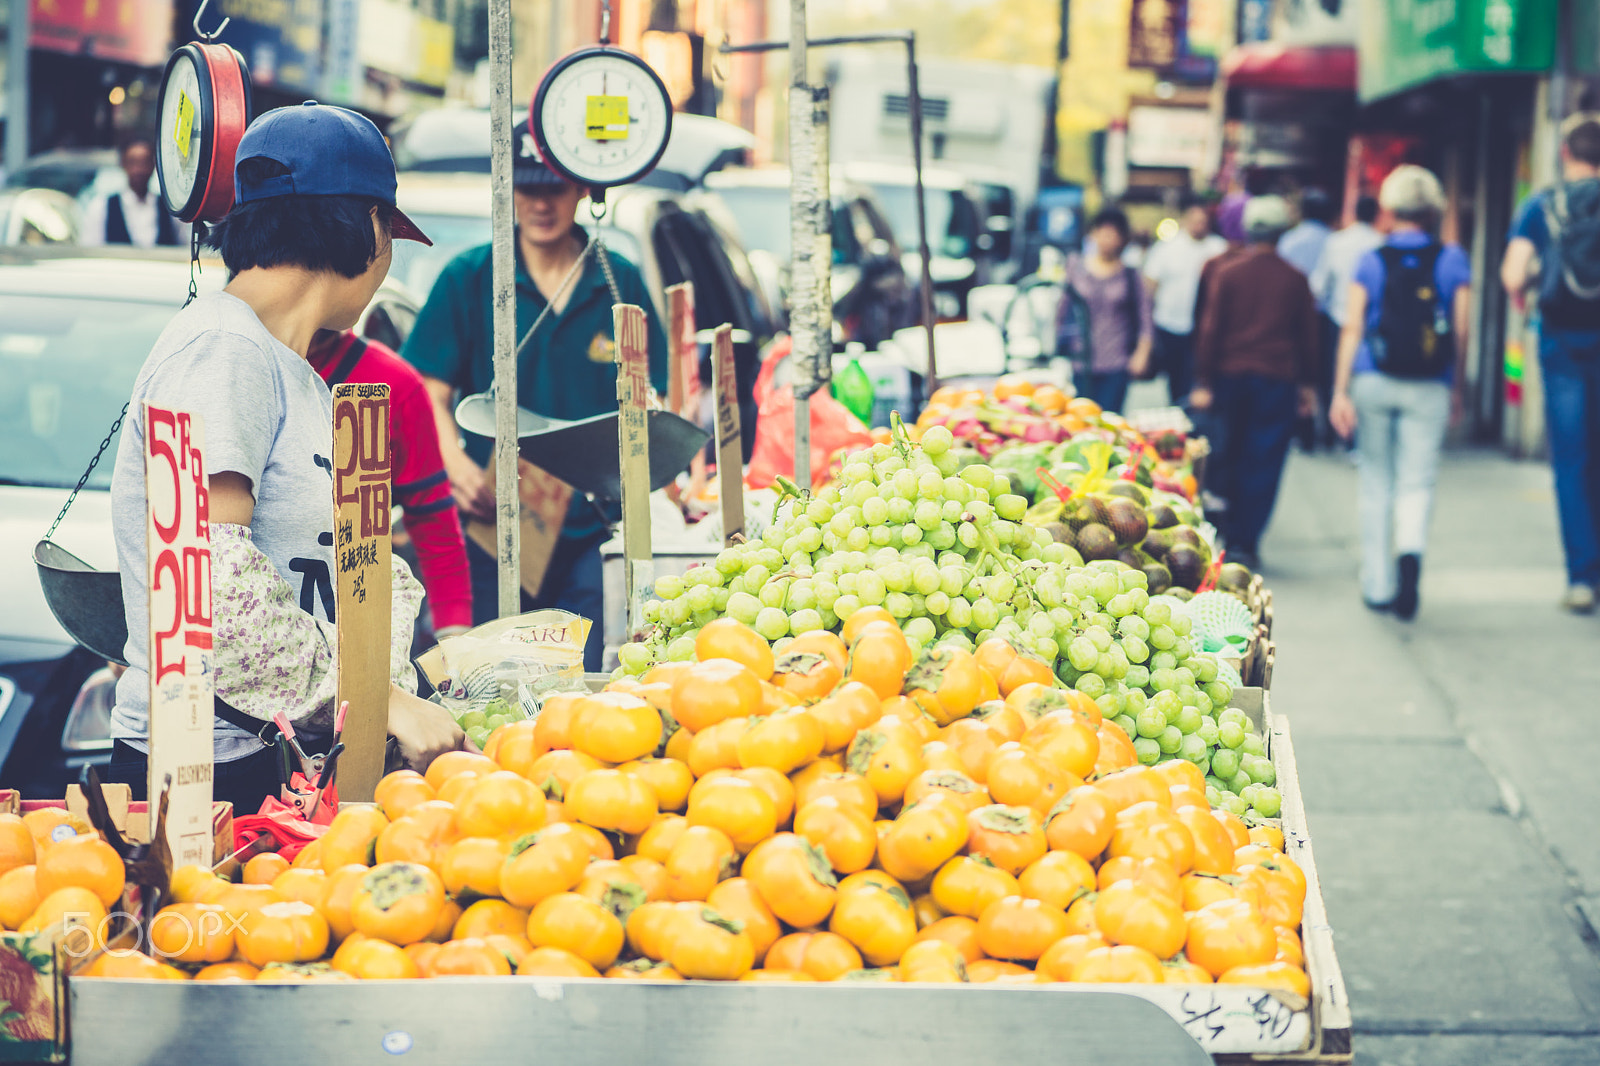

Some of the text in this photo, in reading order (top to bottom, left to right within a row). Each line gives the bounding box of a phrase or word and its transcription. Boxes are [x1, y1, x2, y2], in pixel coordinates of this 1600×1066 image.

[336, 384, 389, 399] SWEET SEEDLESS
[177, 412, 211, 544] FOR
